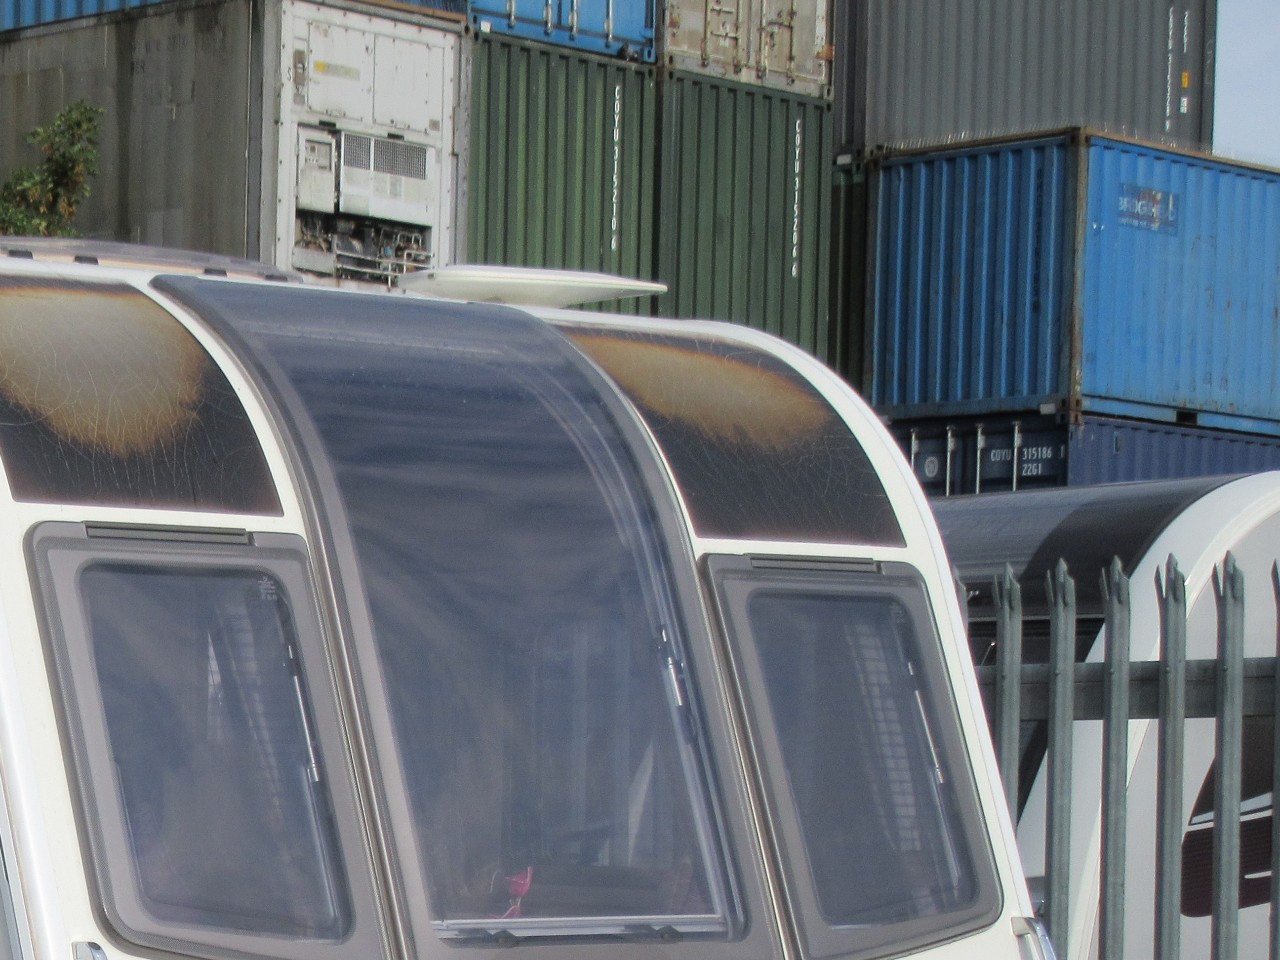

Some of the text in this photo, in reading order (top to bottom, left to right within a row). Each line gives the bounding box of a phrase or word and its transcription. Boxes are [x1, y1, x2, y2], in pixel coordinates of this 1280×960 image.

[611, 146, 619, 231] 315210
[1021, 447, 1053, 461] 315186
[1021, 463, 1042, 476] 22G1
